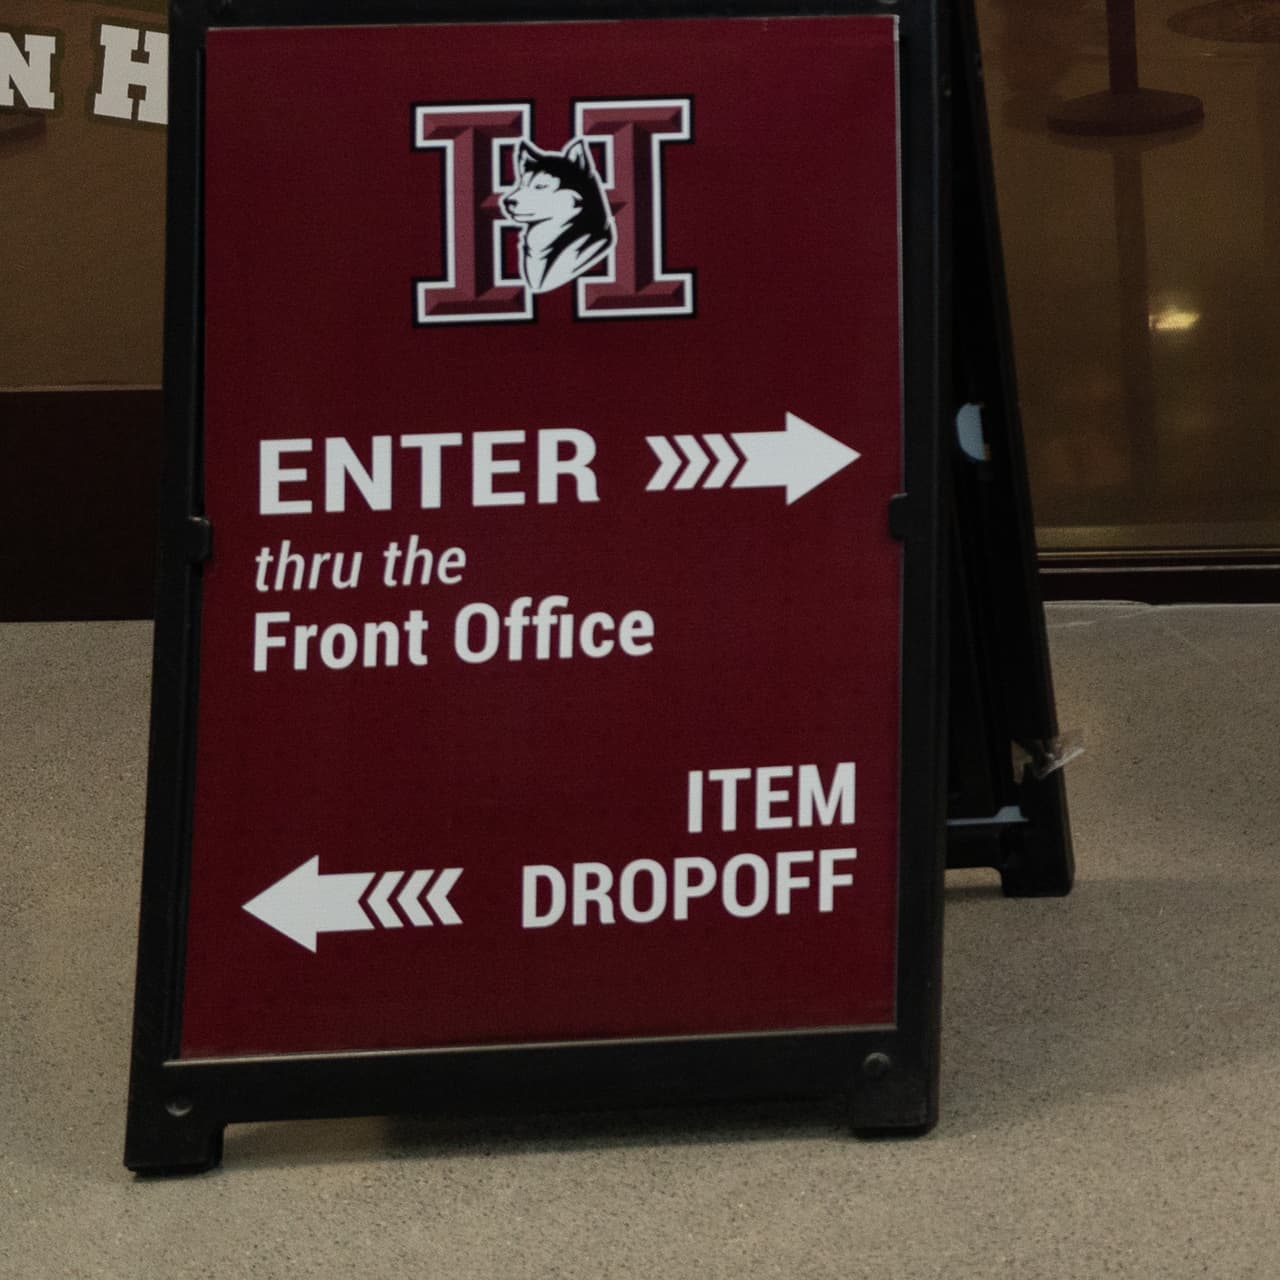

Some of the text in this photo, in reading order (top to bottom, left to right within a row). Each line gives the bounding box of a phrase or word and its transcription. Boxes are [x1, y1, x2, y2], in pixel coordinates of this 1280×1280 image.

[260, 429, 600, 515] ENTER
[255, 535, 467, 592] thru the
[253, 595, 655, 672] Front Office
[687, 761, 857, 833] ITEM
[522, 847, 858, 929] DROPOFF
